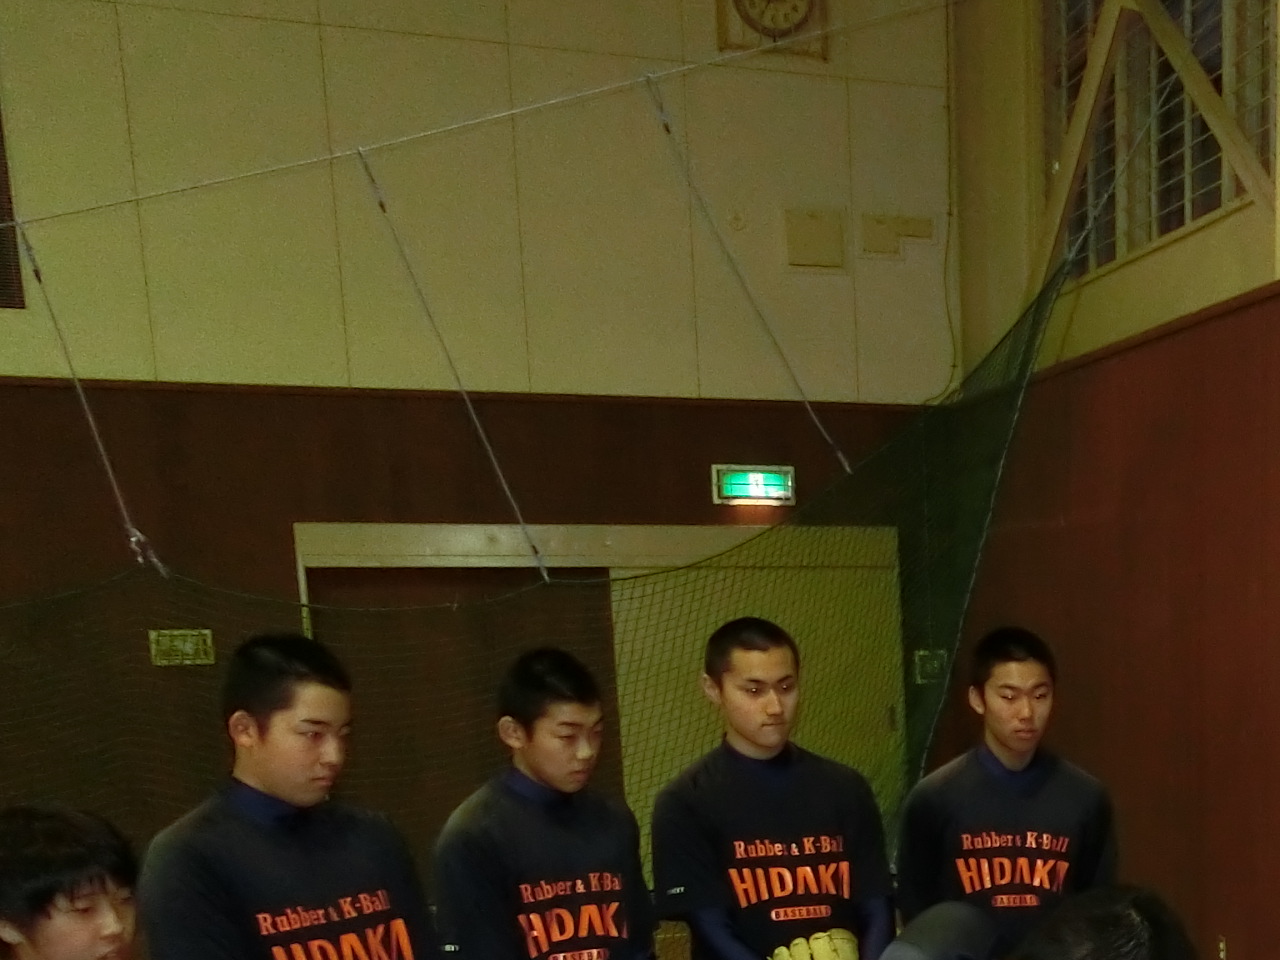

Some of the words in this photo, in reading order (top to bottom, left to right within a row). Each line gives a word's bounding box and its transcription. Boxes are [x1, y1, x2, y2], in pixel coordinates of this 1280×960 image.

[790, 842, 800, 856] &
[575, 879, 586, 893] &
[255, 906, 327, 936] Rubber
